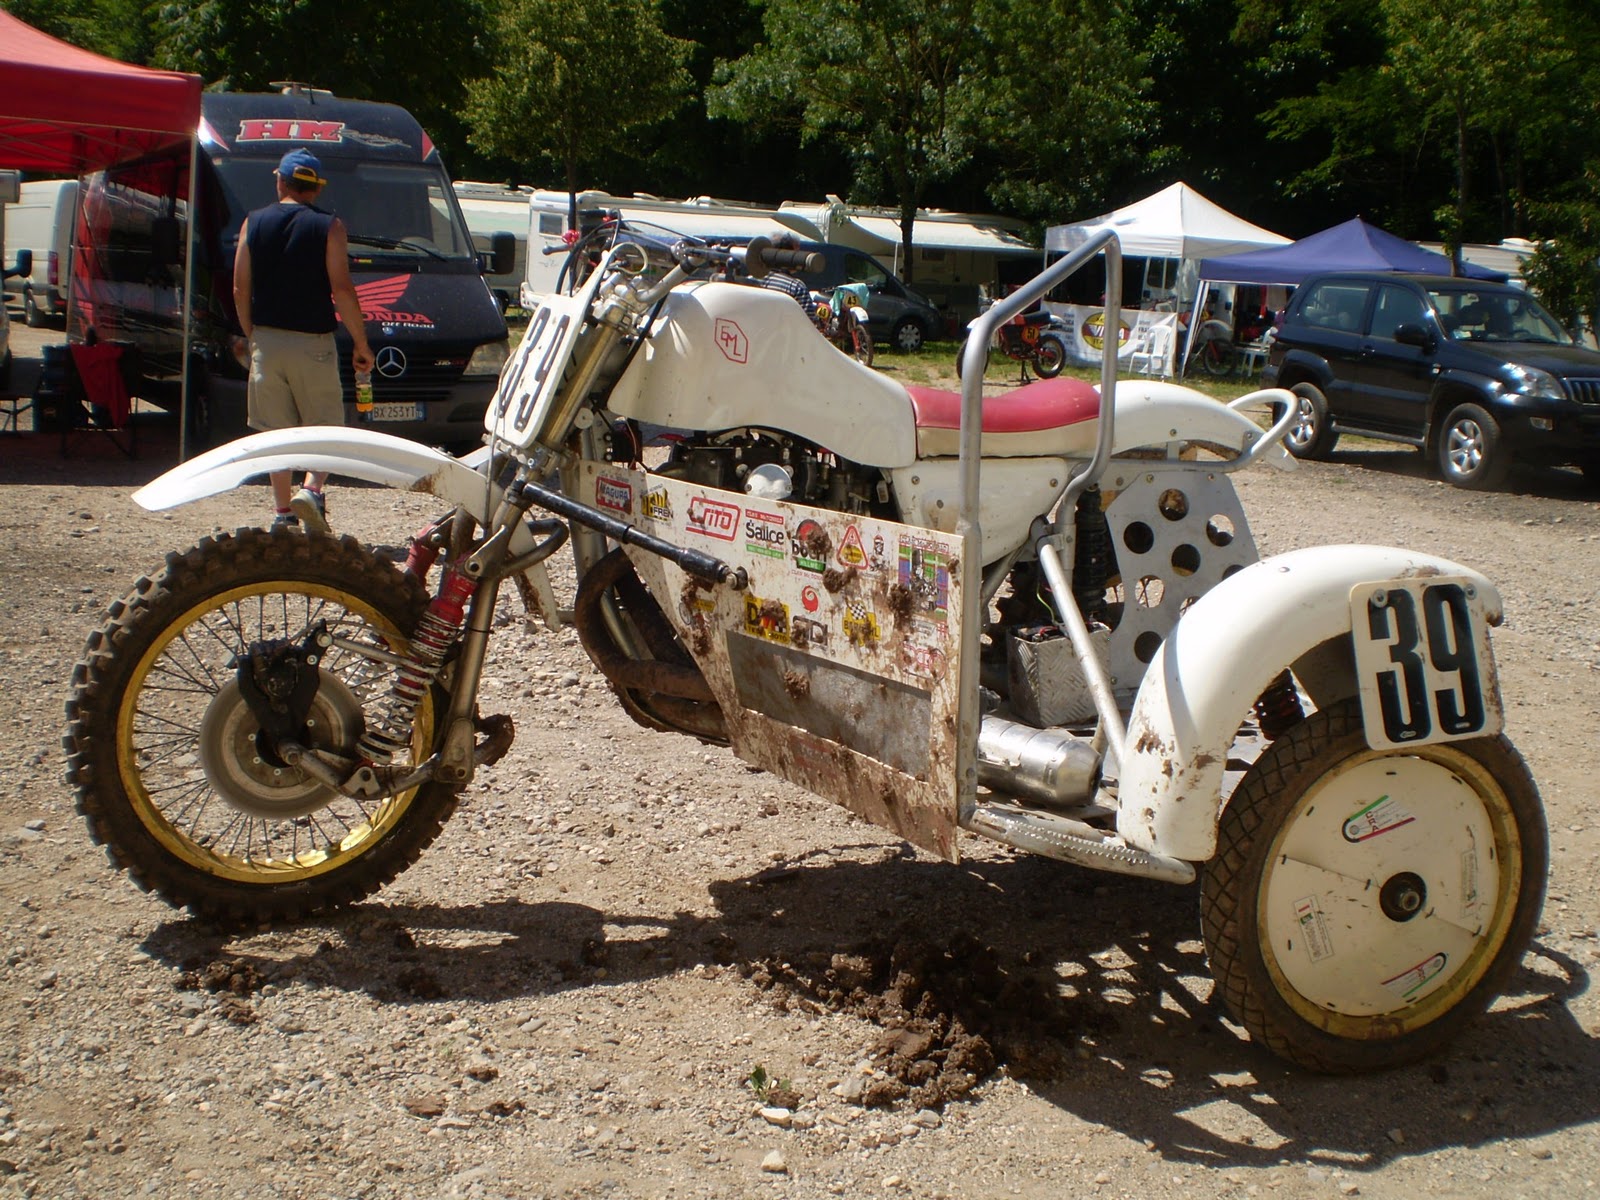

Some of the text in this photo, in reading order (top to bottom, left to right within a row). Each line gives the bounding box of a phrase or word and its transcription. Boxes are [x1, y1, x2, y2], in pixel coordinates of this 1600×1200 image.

[236, 119, 345, 142] HM
[336, 311, 434, 324] ONDA
[1367, 583, 1485, 743] 39
